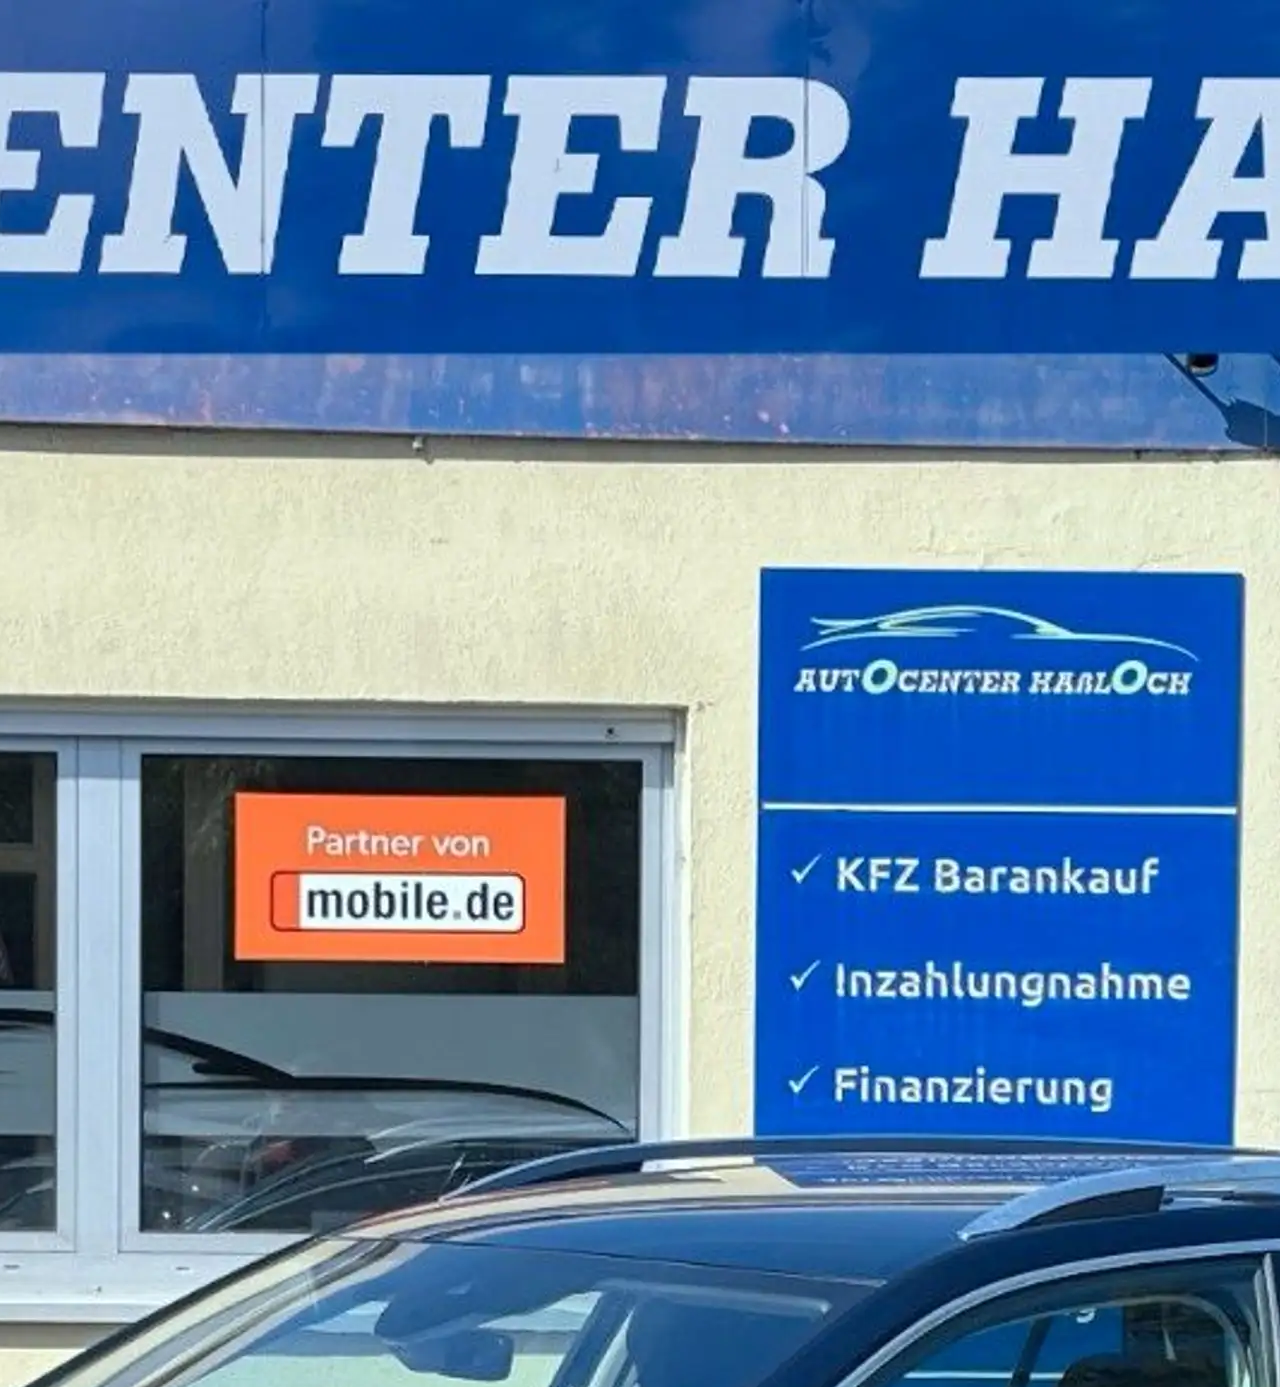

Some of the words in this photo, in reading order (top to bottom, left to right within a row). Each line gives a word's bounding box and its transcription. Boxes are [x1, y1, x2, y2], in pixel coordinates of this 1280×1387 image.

[793, 659, 1021, 695] AUTOCENTER
[306, 826, 424, 856] Partner
[433, 835, 490, 856] von
[837, 858, 919, 892] KFZ
[934, 858, 1160, 895] Barankauf
[307, 882, 514, 920] mobile.de
[835, 962, 1191, 1006] Inzahlungnahme
[834, 1067, 1112, 1112] Finanzierung
